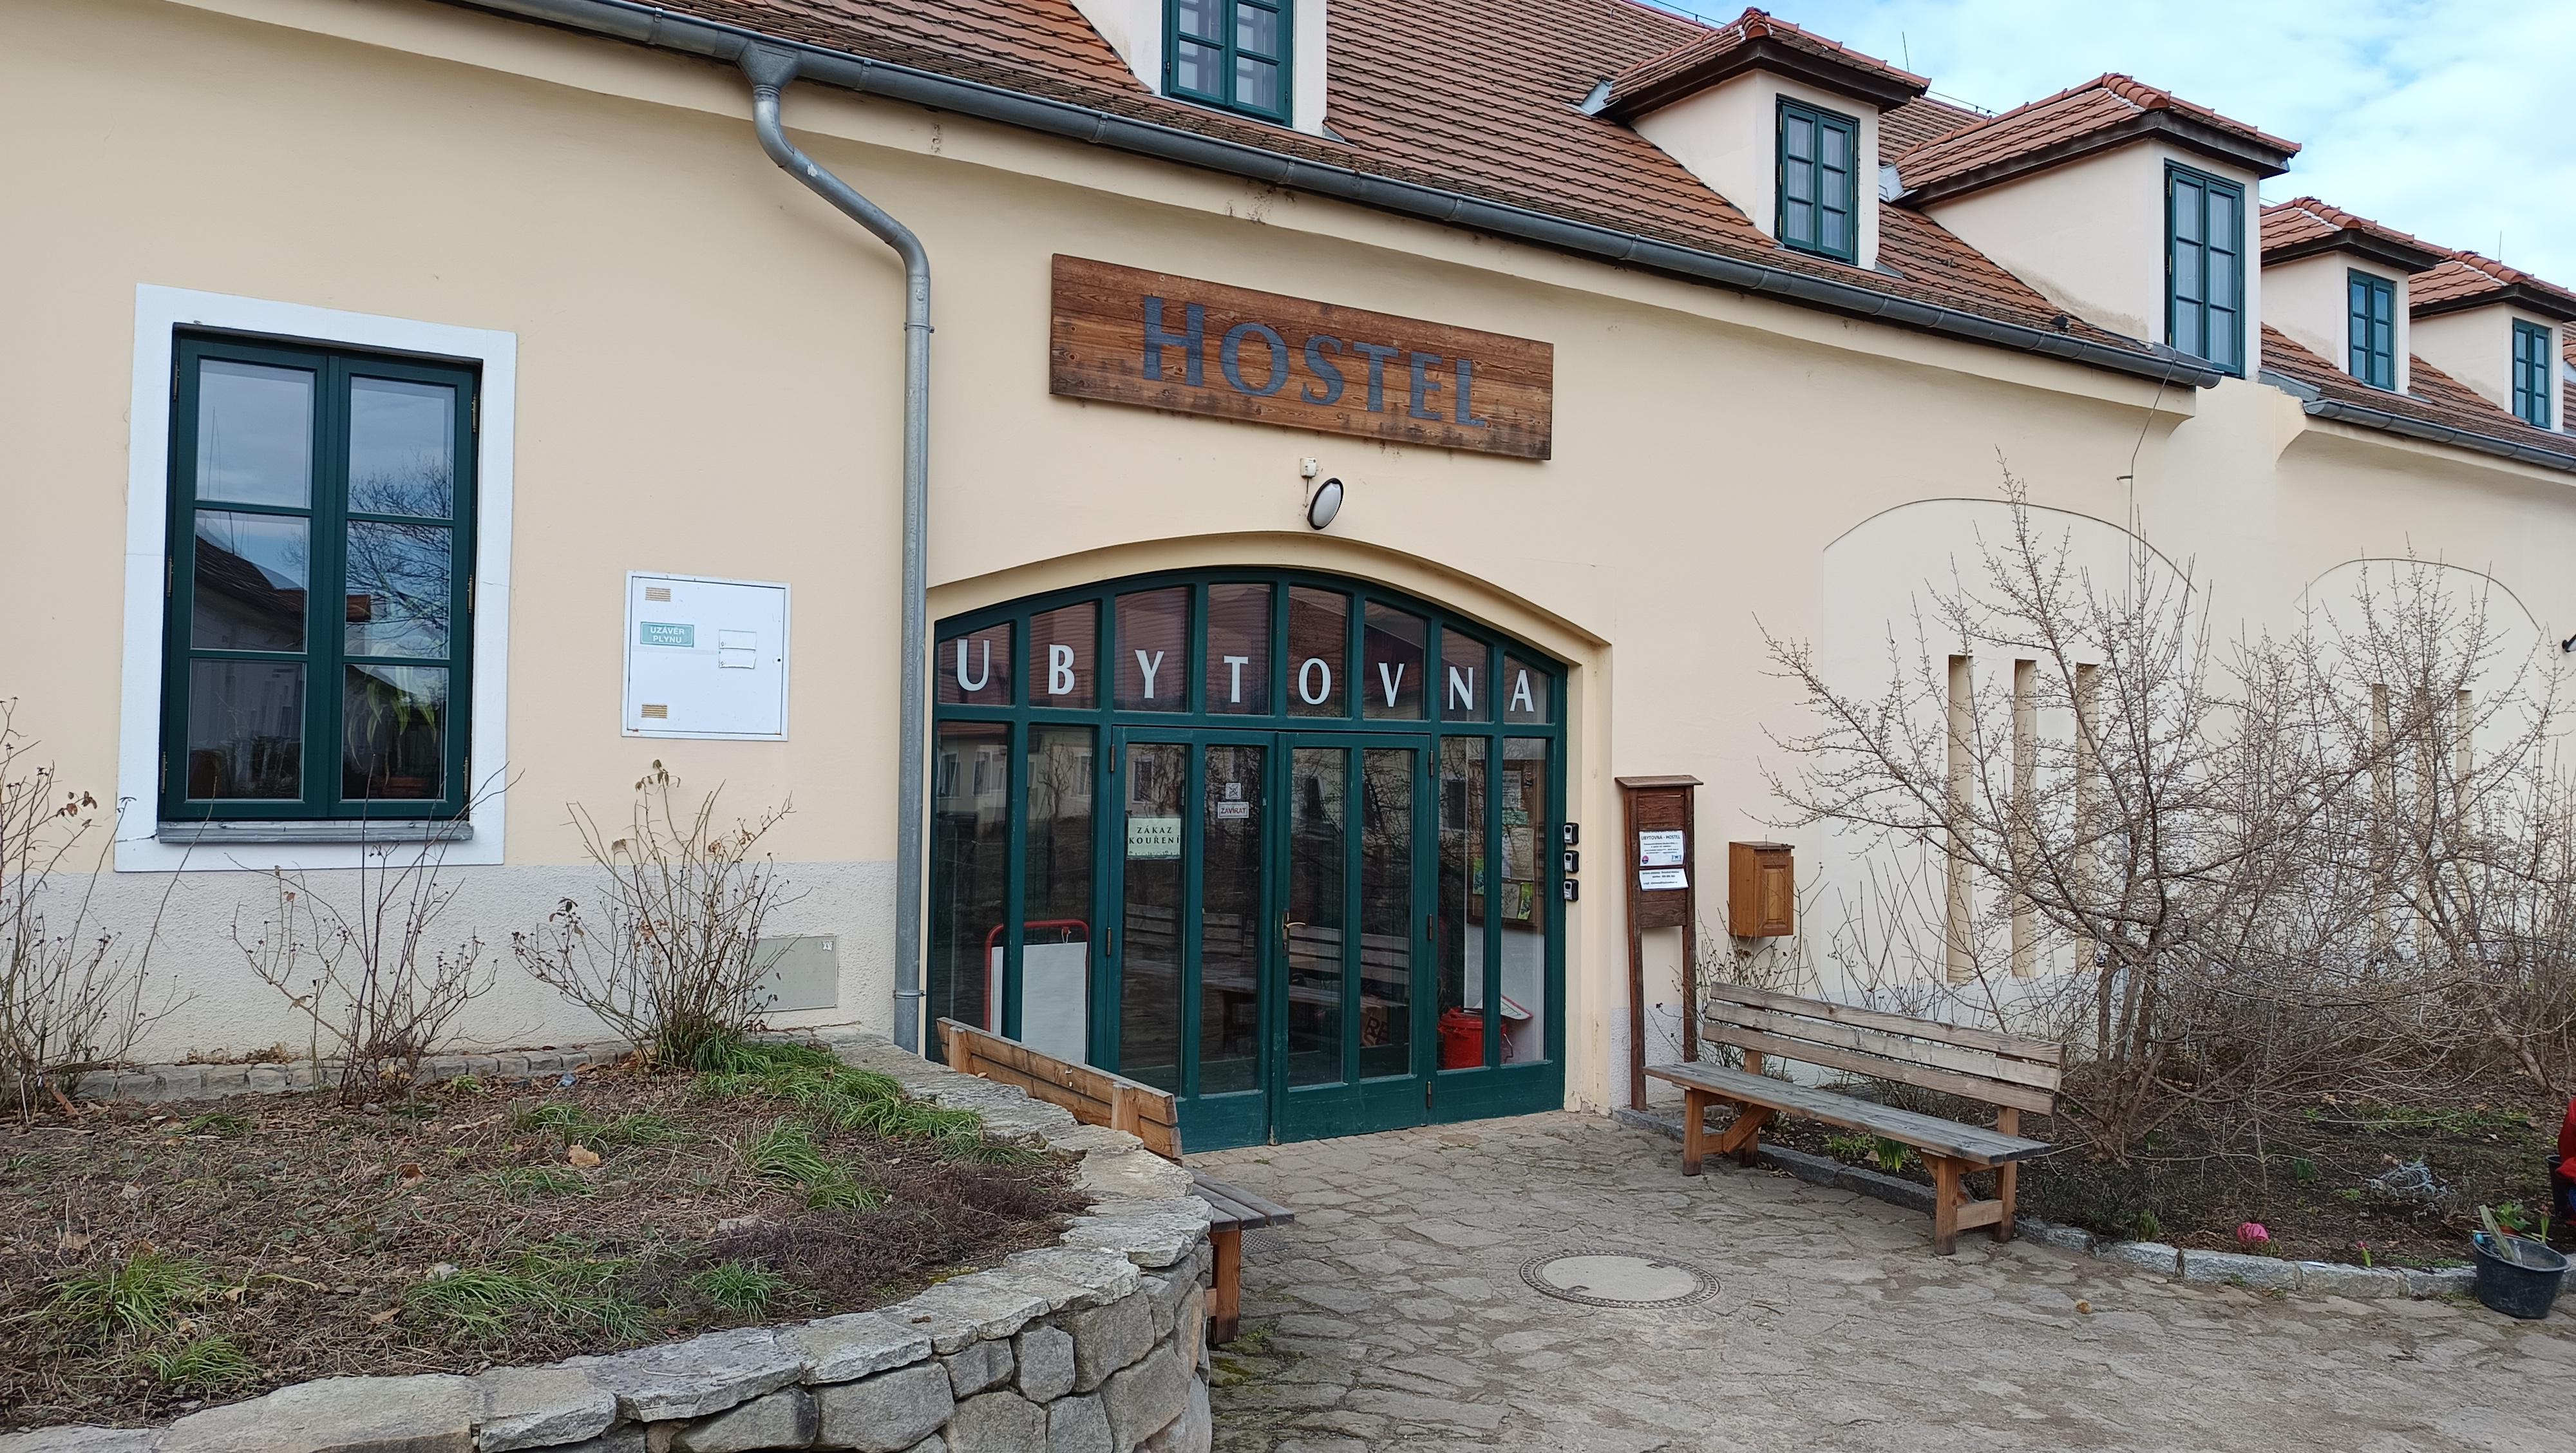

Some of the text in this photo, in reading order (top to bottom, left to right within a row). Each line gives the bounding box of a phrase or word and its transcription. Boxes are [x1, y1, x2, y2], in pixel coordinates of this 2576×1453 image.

[1142, 294, 1486, 428] HOSTEL
[653, 635, 682, 643] PLYNU
[956, 639, 1535, 712] UBYTOVNA
[1137, 825, 1172, 834] ZÁKAZ
[1129, 835, 1180, 844] KOUŘENÍ
